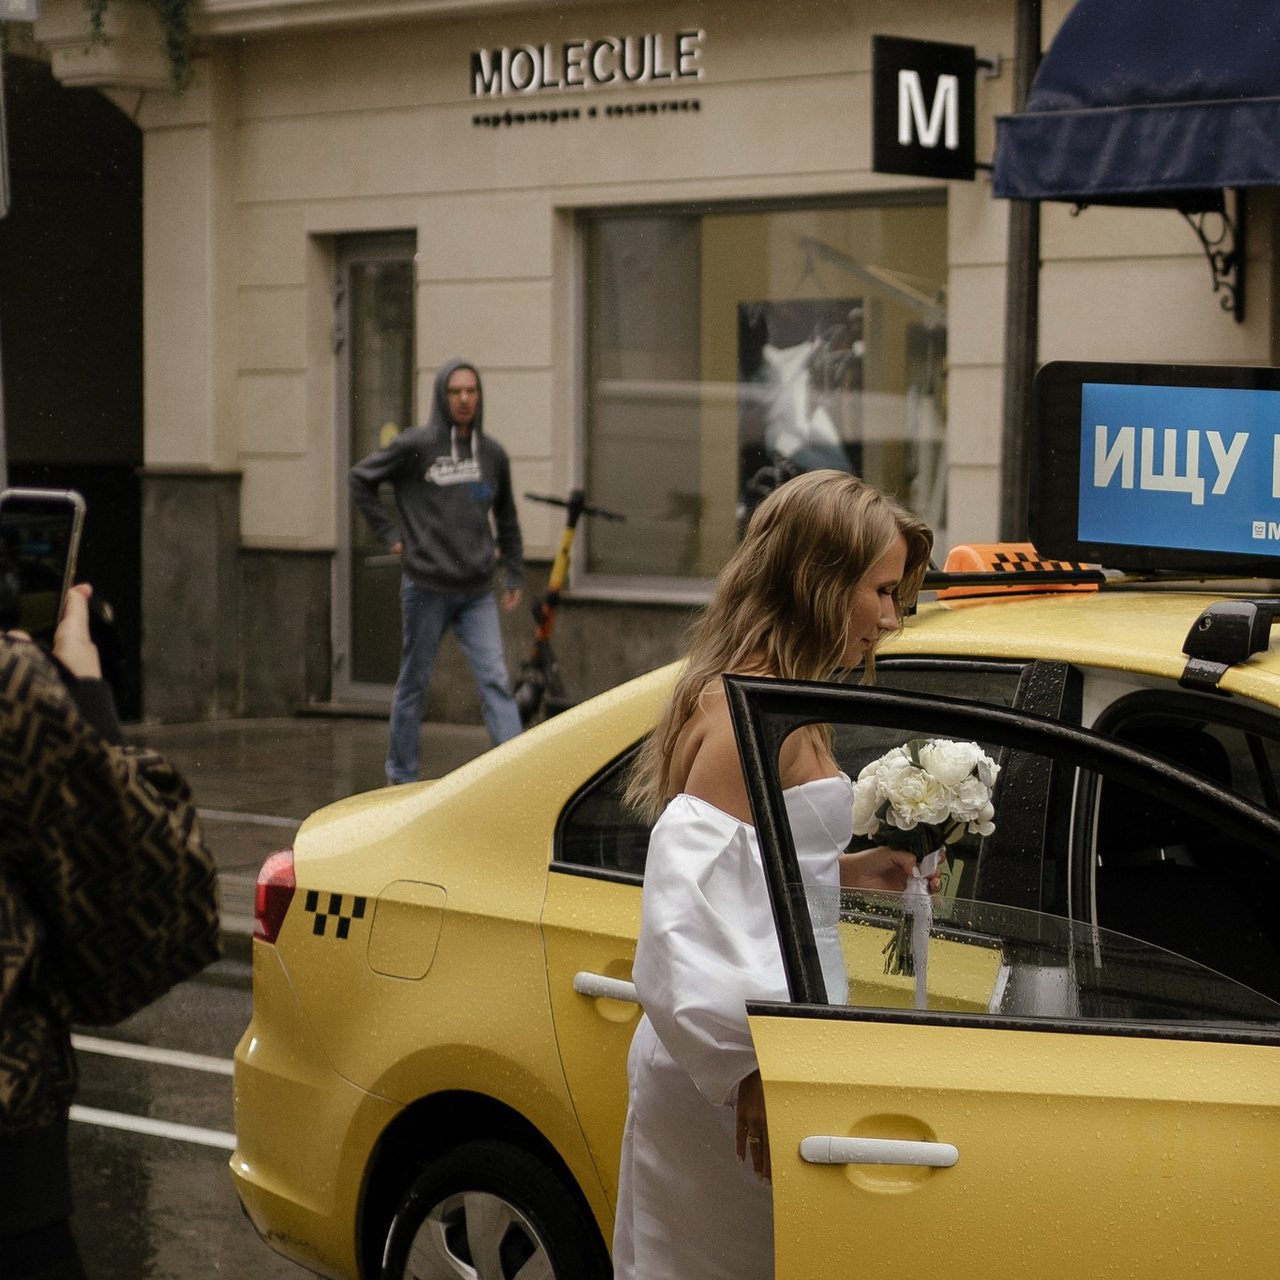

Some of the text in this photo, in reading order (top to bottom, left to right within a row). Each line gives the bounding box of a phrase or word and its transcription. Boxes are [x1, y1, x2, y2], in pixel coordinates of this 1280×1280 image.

[470, 28, 706, 99] MOLECULE
[898, 69, 959, 150] M
[1094, 425, 1250, 505] ИЩУ
